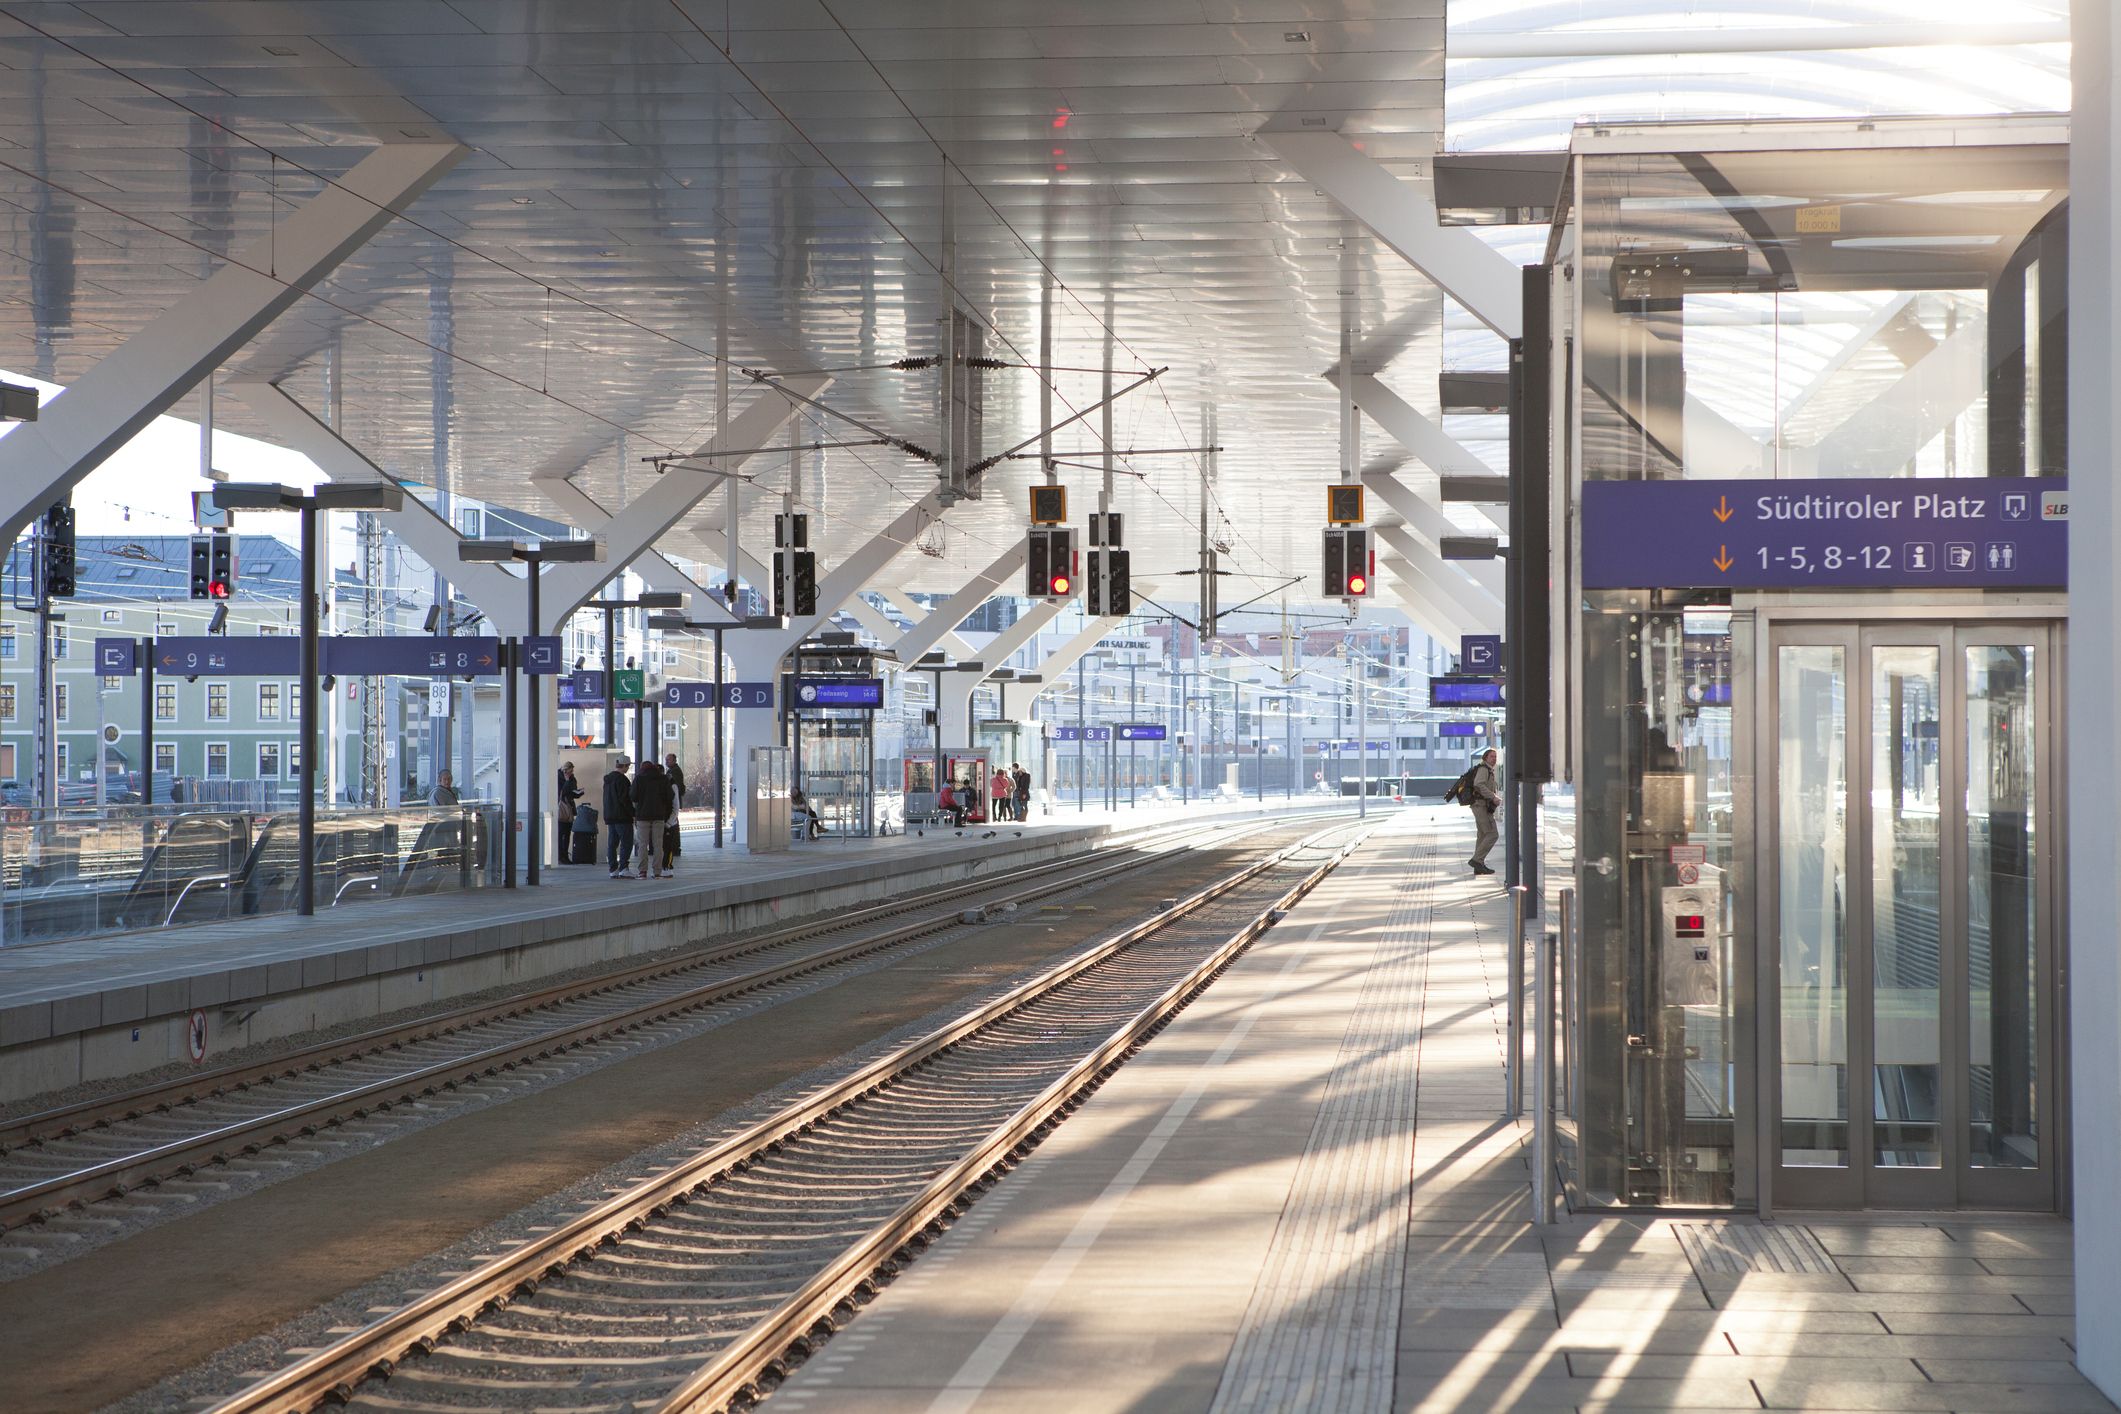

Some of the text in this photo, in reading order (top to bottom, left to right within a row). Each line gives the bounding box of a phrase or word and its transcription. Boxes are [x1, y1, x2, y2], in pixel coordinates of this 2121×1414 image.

[1756, 494, 1985, 520] Südtiroler Platz
[2044, 504, 2069, 515] SLB
[1823, 545, 1892, 570] 8-12
[187, 652, 197, 668] 9
[457, 652, 468, 668] 8
[432, 685, 447, 698] 88
[669, 687, 705, 704] 9 D
[730, 687, 767, 704] 8 D
[435, 701, 443, 713] 3
[1055, 729, 1074, 739] 9 E
[1087, 729, 1106, 739] 8 E
[1689, 916, 1700, 929] 0
